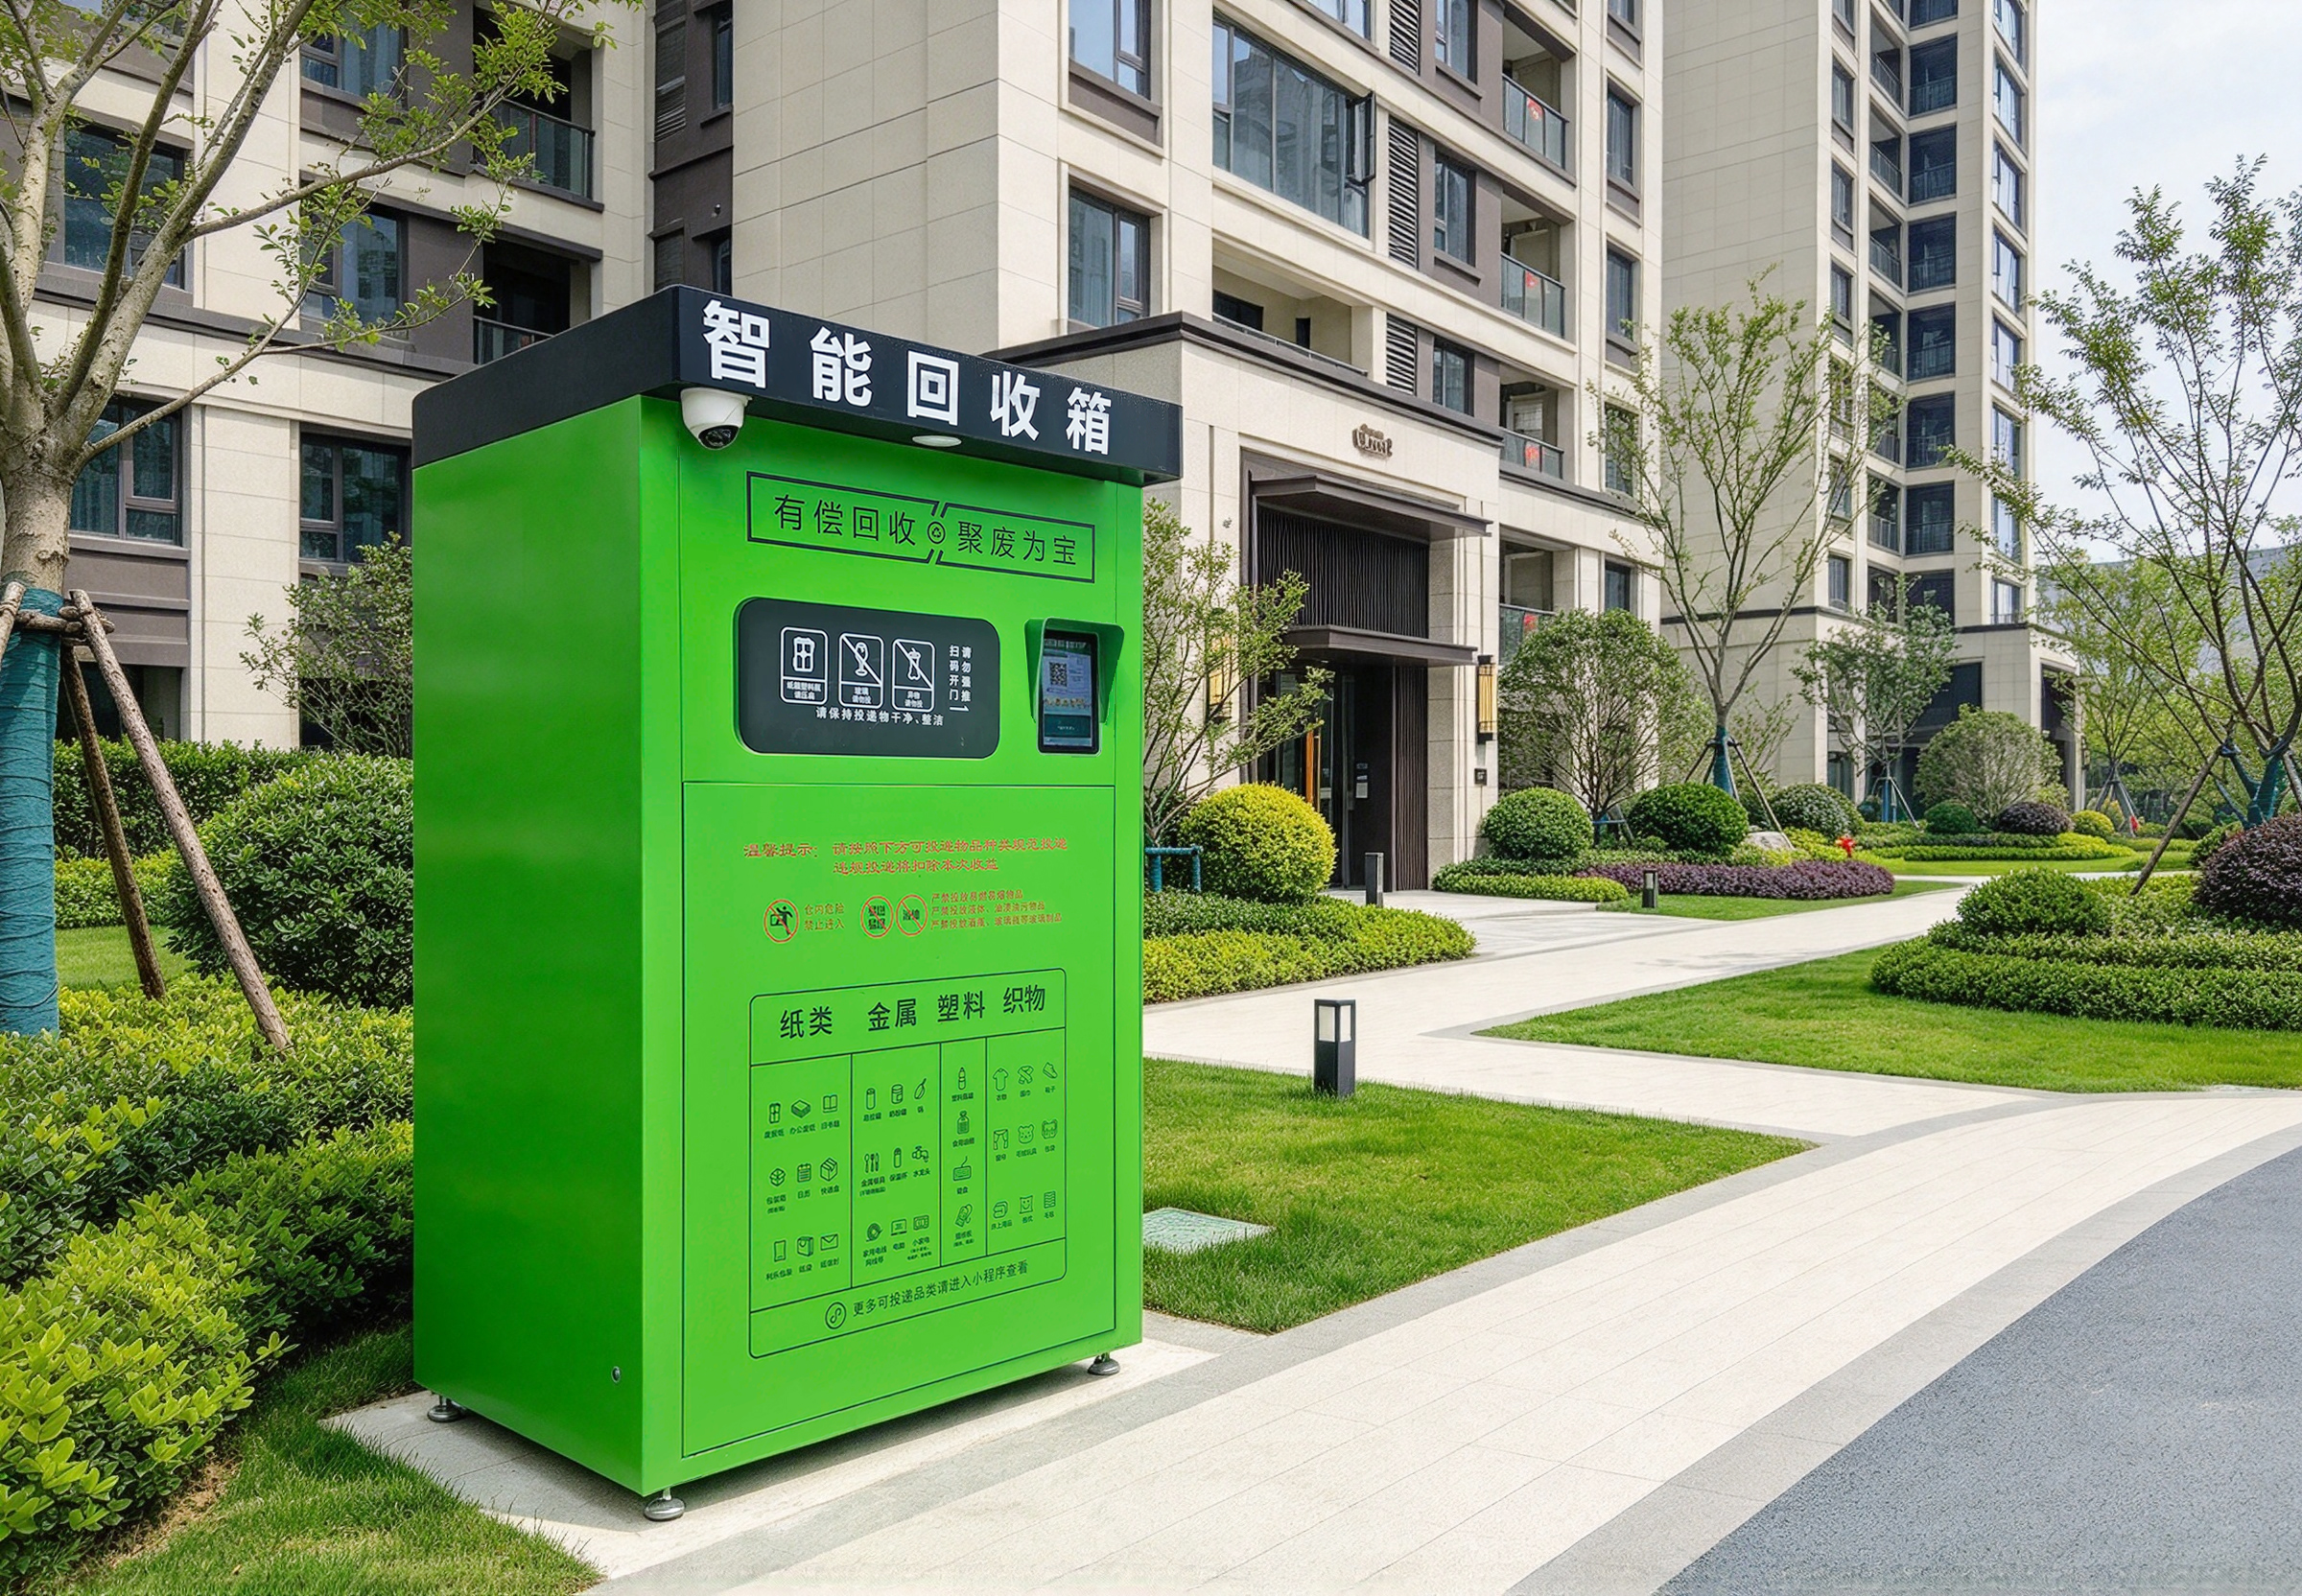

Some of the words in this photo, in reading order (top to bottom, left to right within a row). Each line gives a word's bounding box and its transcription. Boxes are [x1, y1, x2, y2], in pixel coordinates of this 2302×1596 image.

[702, 299, 1113, 456] 智能回收箱
[774, 493, 916, 547] 有偿回收
[957, 520, 1077, 566] 聚废为宝
[949, 645, 960, 701] 扫码开门
[961, 645, 973, 702] 请勿强推
[815, 706, 944, 727] 请保持投递物干净、整洁
[833, 857, 999, 875] 违规投递将扣除本次收益
[804, 918, 845, 931] 禁止进入
[867, 998, 917, 1032] 金属
[937, 990, 986, 1023] 塑料
[1002, 984, 1046, 1015] 织物
[780, 1005, 833, 1040] 纸类
[853, 1259, 1028, 1318] 更多可投递品类请进入小程序查看
